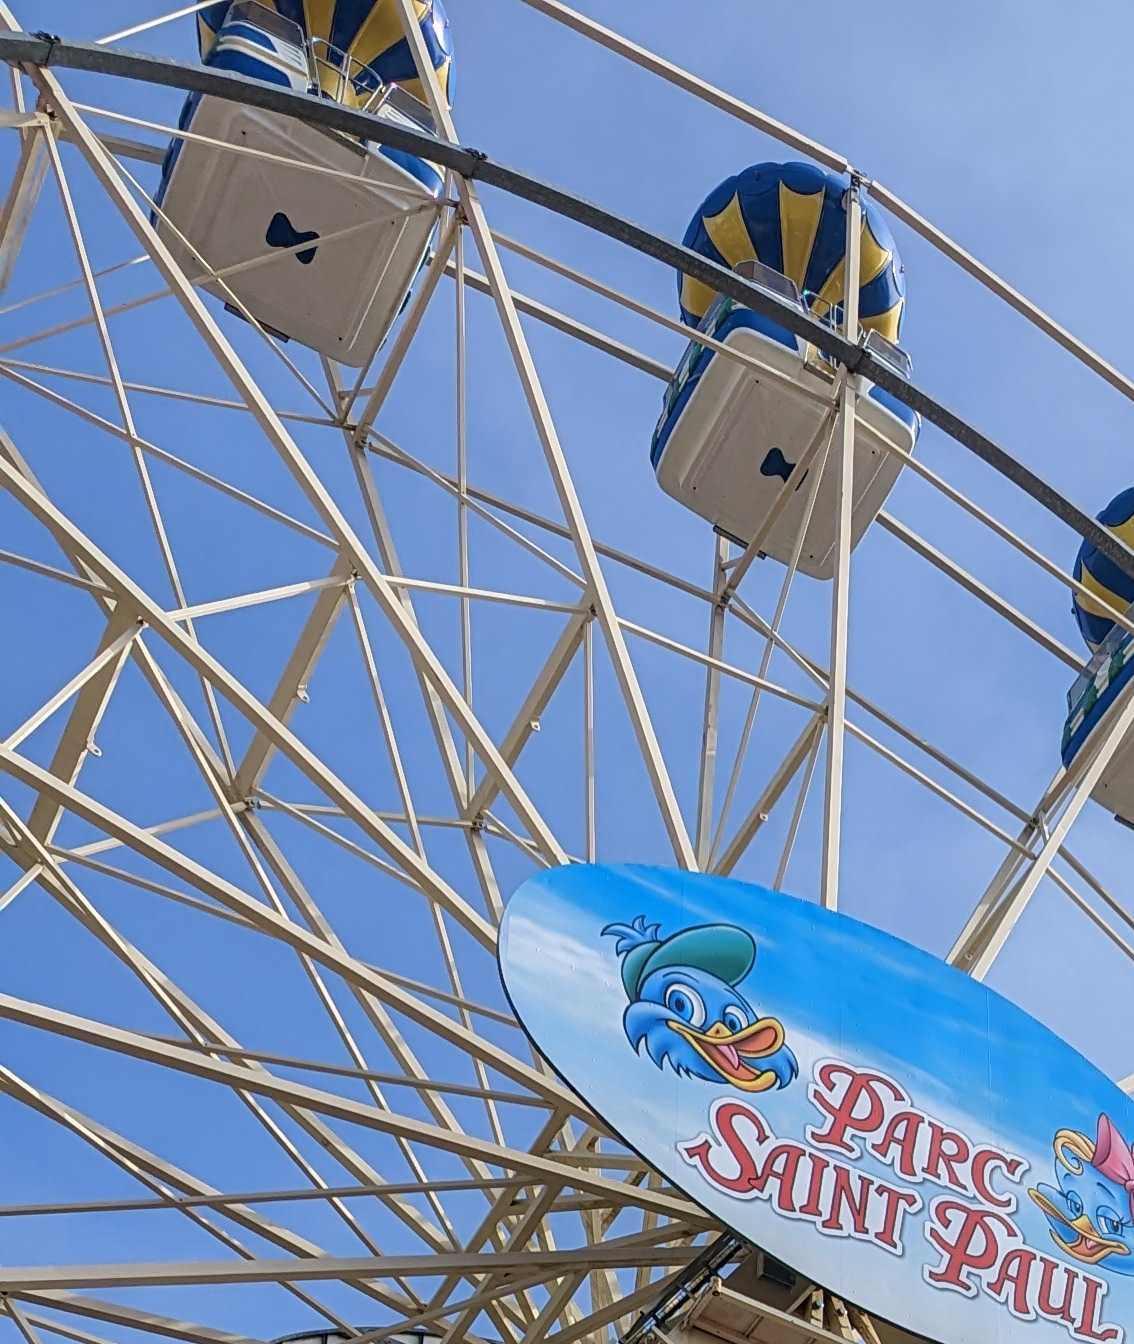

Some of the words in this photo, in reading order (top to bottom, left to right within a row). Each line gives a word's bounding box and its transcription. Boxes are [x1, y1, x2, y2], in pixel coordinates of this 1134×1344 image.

[686, 1103, 916, 1246] SAINT
[926, 1201, 1122, 1343] PAUL
[812, 1063, 1024, 1208] PARC
